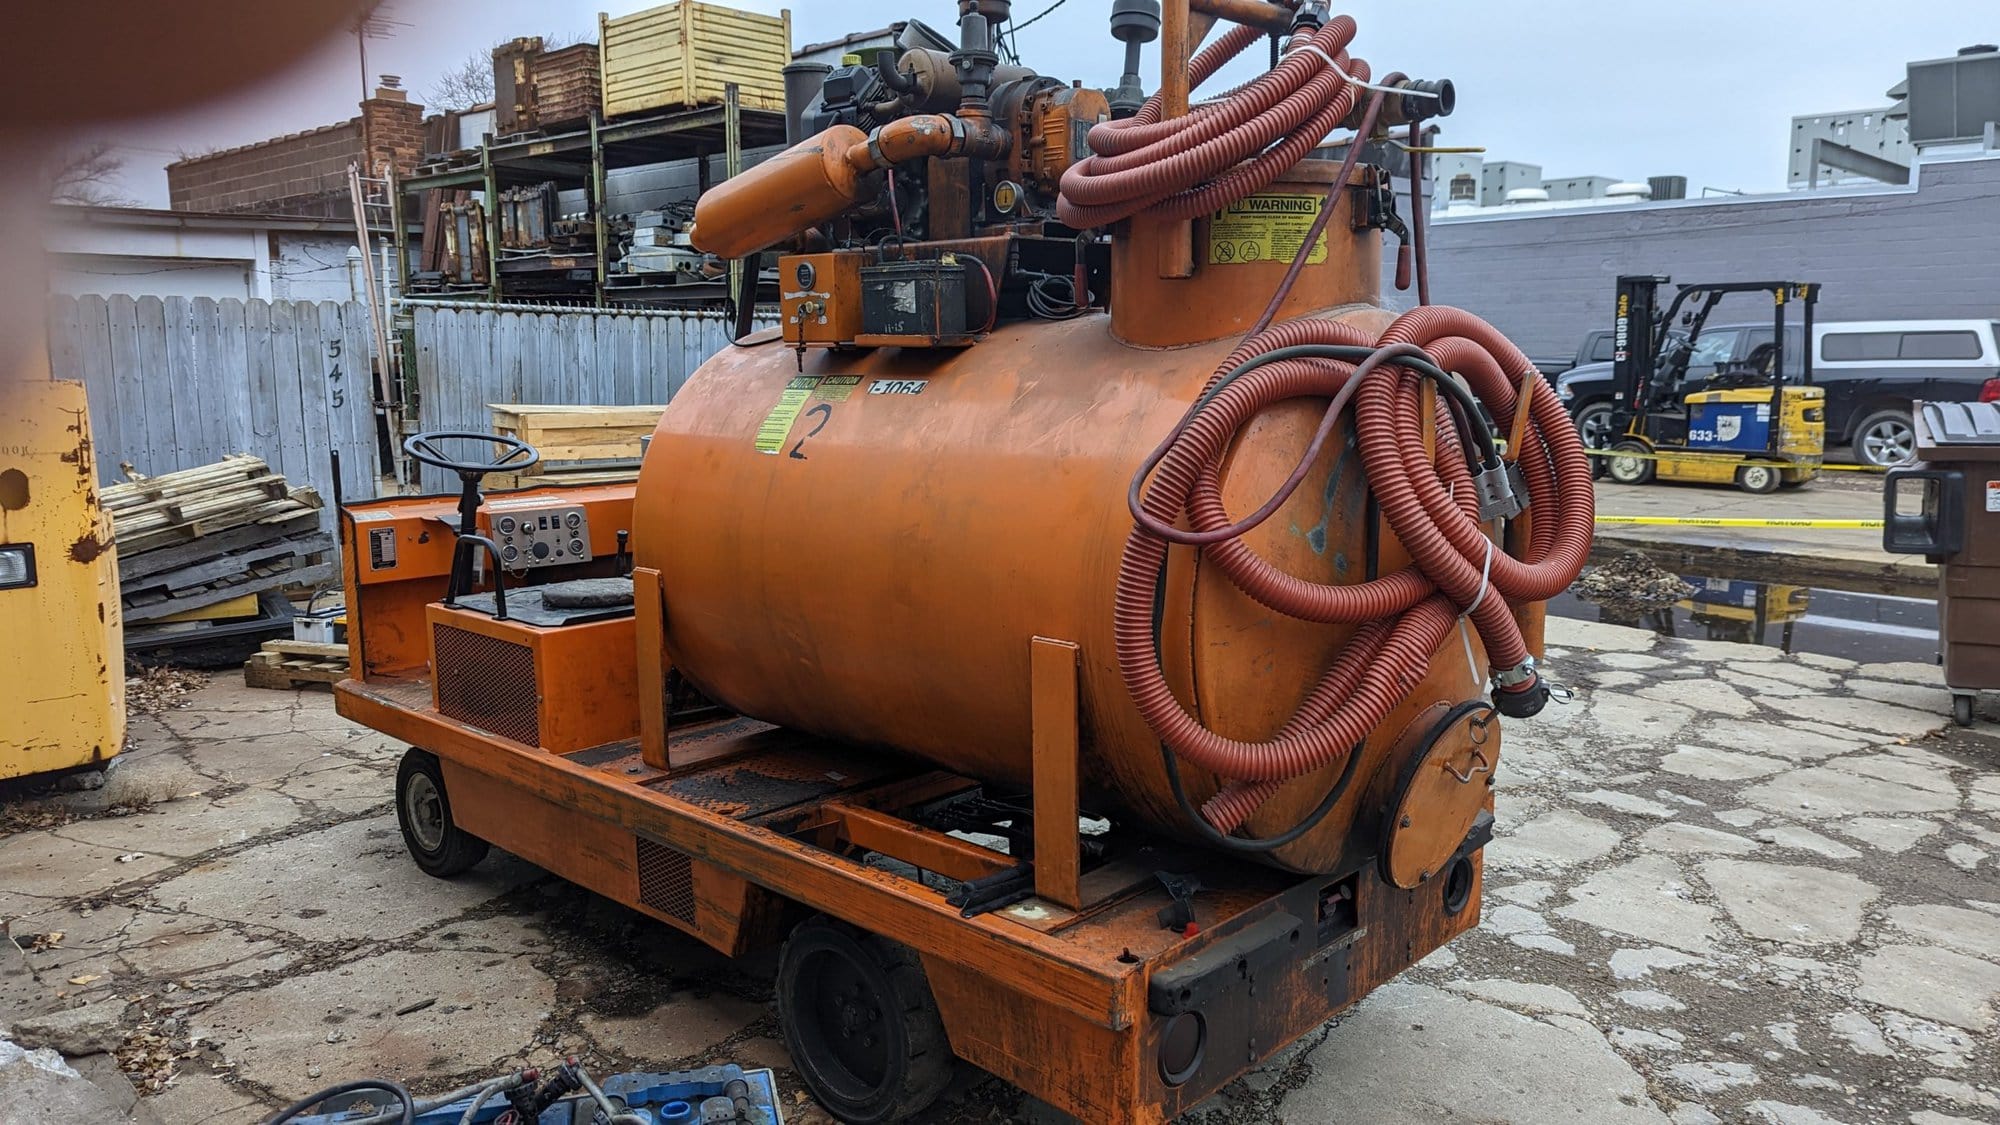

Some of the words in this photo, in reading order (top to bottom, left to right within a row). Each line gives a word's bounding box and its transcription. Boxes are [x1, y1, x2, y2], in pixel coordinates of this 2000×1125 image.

[1249, 199, 1312, 211] WARNING
[1617, 294, 1628, 317] Yale
[328, 339, 344, 409] 545
[825, 375, 861, 385] CAUTION
[789, 403, 833, 461] 2
